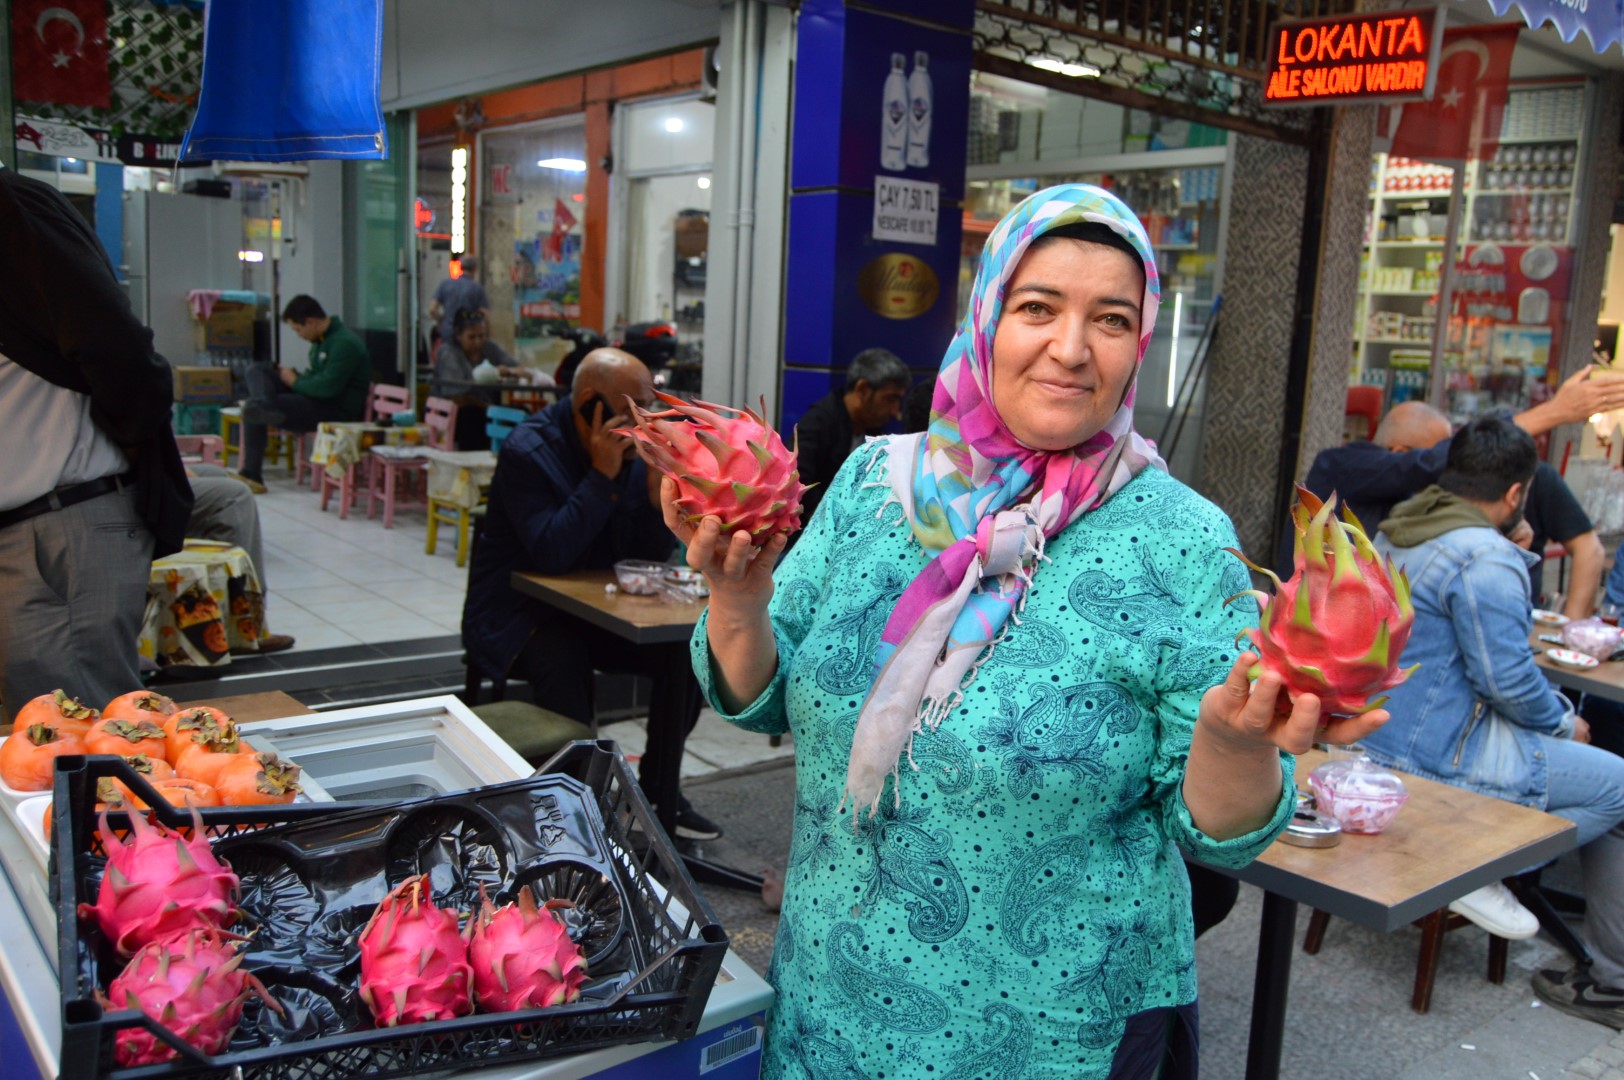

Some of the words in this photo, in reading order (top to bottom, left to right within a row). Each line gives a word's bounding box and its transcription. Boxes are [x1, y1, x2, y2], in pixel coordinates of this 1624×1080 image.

[1278, 16, 1423, 64] LOKANTA
[1266, 64, 1301, 99] AİLE
[1301, 65, 1363, 96] SALONU
[1365, 60, 1426, 92] VARDIR
[879, 184, 900, 213] ÇAY
[924, 190, 936, 212] TL
